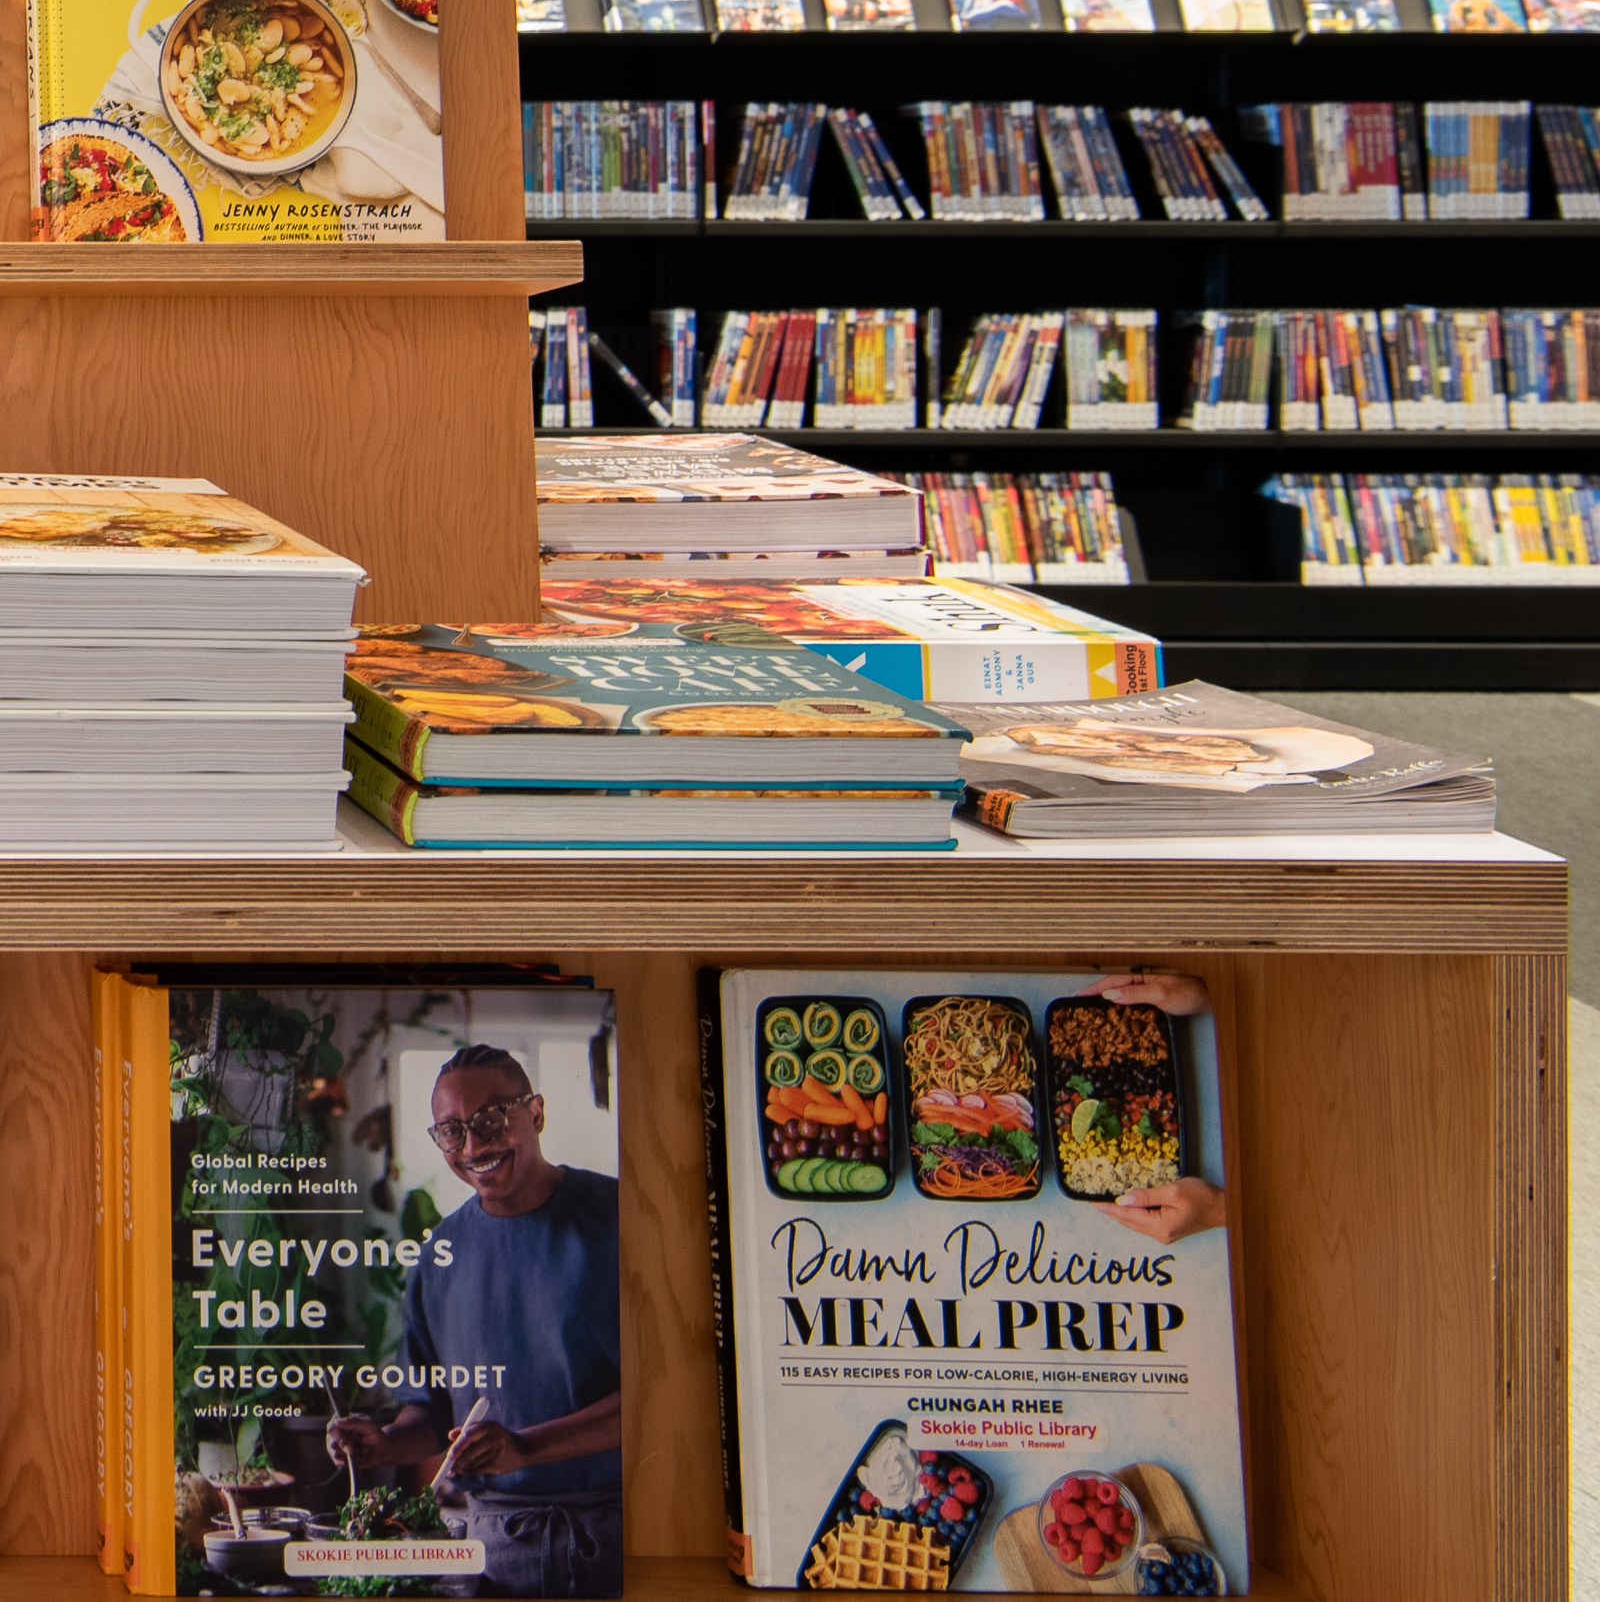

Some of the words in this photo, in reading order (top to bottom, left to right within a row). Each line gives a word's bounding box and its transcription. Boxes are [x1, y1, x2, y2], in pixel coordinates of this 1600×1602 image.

[222, 203, 280, 222] JENNY
[287, 204, 412, 218] ROSENSTRACH
[549, 655, 798, 666] SWEET
[1138, 649, 1148, 676] Floor
[566, 665, 832, 677] HOME
[983, 656, 992, 690] EINAT
[993, 650, 1002, 696] ADMONY
[1005, 669, 1012, 677] &
[1016, 654, 1025, 692] JANNA
[1026, 661, 1035, 684] GUR
[591, 677, 860, 691] CAFE
[191, 1154, 252, 1172] Global
[257, 1154, 327, 1172] Recipes
[191, 1179, 218, 1194] for
[222, 1179, 293, 1194] Modern
[298, 1179, 358, 1194] Health
[191, 1228, 454, 1276] Everyone's
[770, 1217, 937, 1295] Damn
[944, 1217, 1176, 1295] Delicious
[192, 1289, 328, 1329] Table
[778, 1296, 982, 1350] MEAL
[991, 1299, 1186, 1353] PREP
[193, 1365, 344, 1389] GREGORY
[355, 1365, 507, 1389] GOURDET
[803, 1367, 840, 1379] EASY
[843, 1367, 901, 1380] RECIPES
[903, 1368, 933, 1380] FOR
[936, 1369, 1040, 1383] LOW-CALORIE,
[1042, 1370, 1138, 1384] HIGH-ENERGY
[1141, 1372, 1190, 1384] LIVING
[194, 1403, 227, 1418] with
[231, 1403, 248, 1418] JJ
[252, 1403, 302, 1418] Goode
[907, 1396, 1007, 1414] CHUNGAH
[1012, 1396, 1064, 1414] RHEE
[921, 1420, 978, 1435] Skokie
[982, 1420, 1034, 1436] Public
[1038, 1421, 1098, 1440] Library
